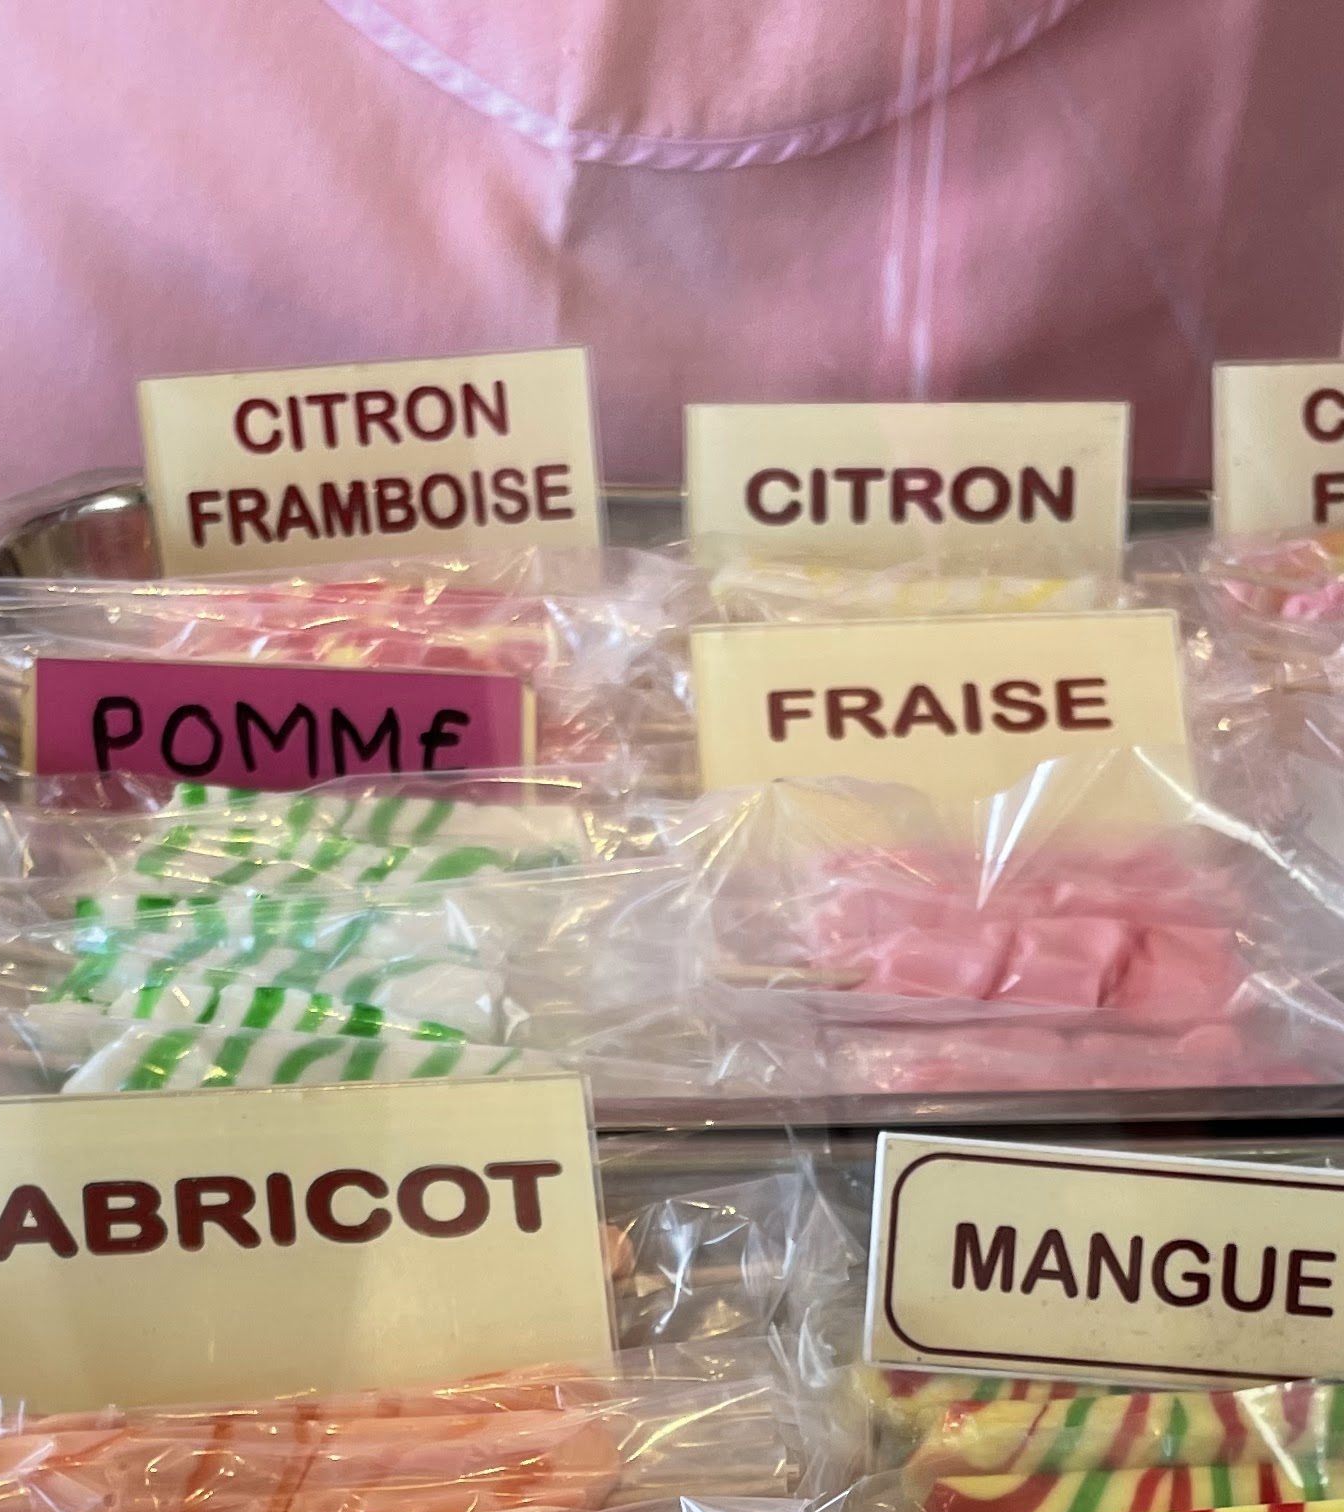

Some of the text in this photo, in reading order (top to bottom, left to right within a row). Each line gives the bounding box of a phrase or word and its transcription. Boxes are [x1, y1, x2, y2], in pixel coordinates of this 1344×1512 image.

[235, 381, 507, 454] CITRON
[188, 465, 573, 549] FRAMBOISE
[746, 466, 1074, 525] CITRON
[93, 696, 469, 779] POMME
[768, 678, 1112, 741] FRAISE
[953, 1223, 1336, 1317] MANGUE
